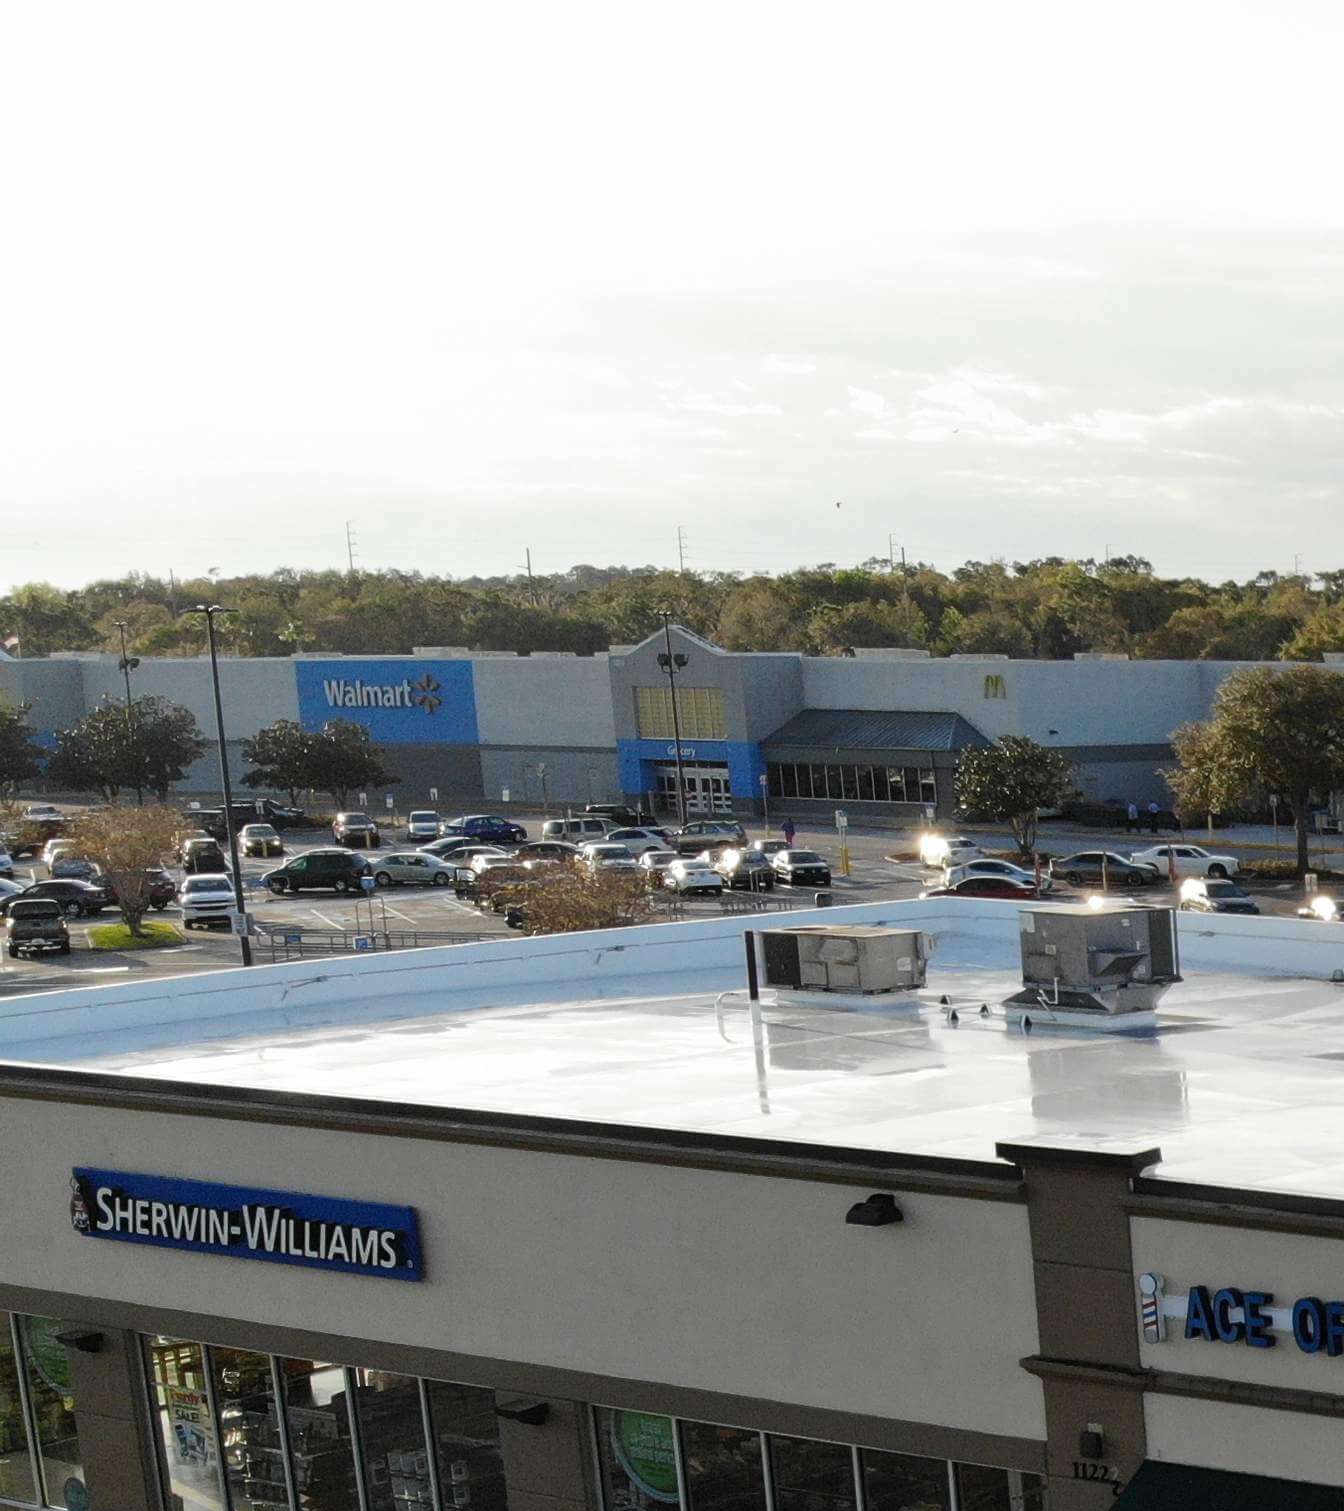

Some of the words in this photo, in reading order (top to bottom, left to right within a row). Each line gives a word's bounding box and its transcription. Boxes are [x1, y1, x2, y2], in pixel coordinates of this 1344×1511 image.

[323, 679, 412, 708] Walmart
[666, 744, 697, 759] Grcery
[96, 1187, 397, 1269] SHERWIN-WILLIAMS
[1184, 1285, 1276, 1348] ACE
